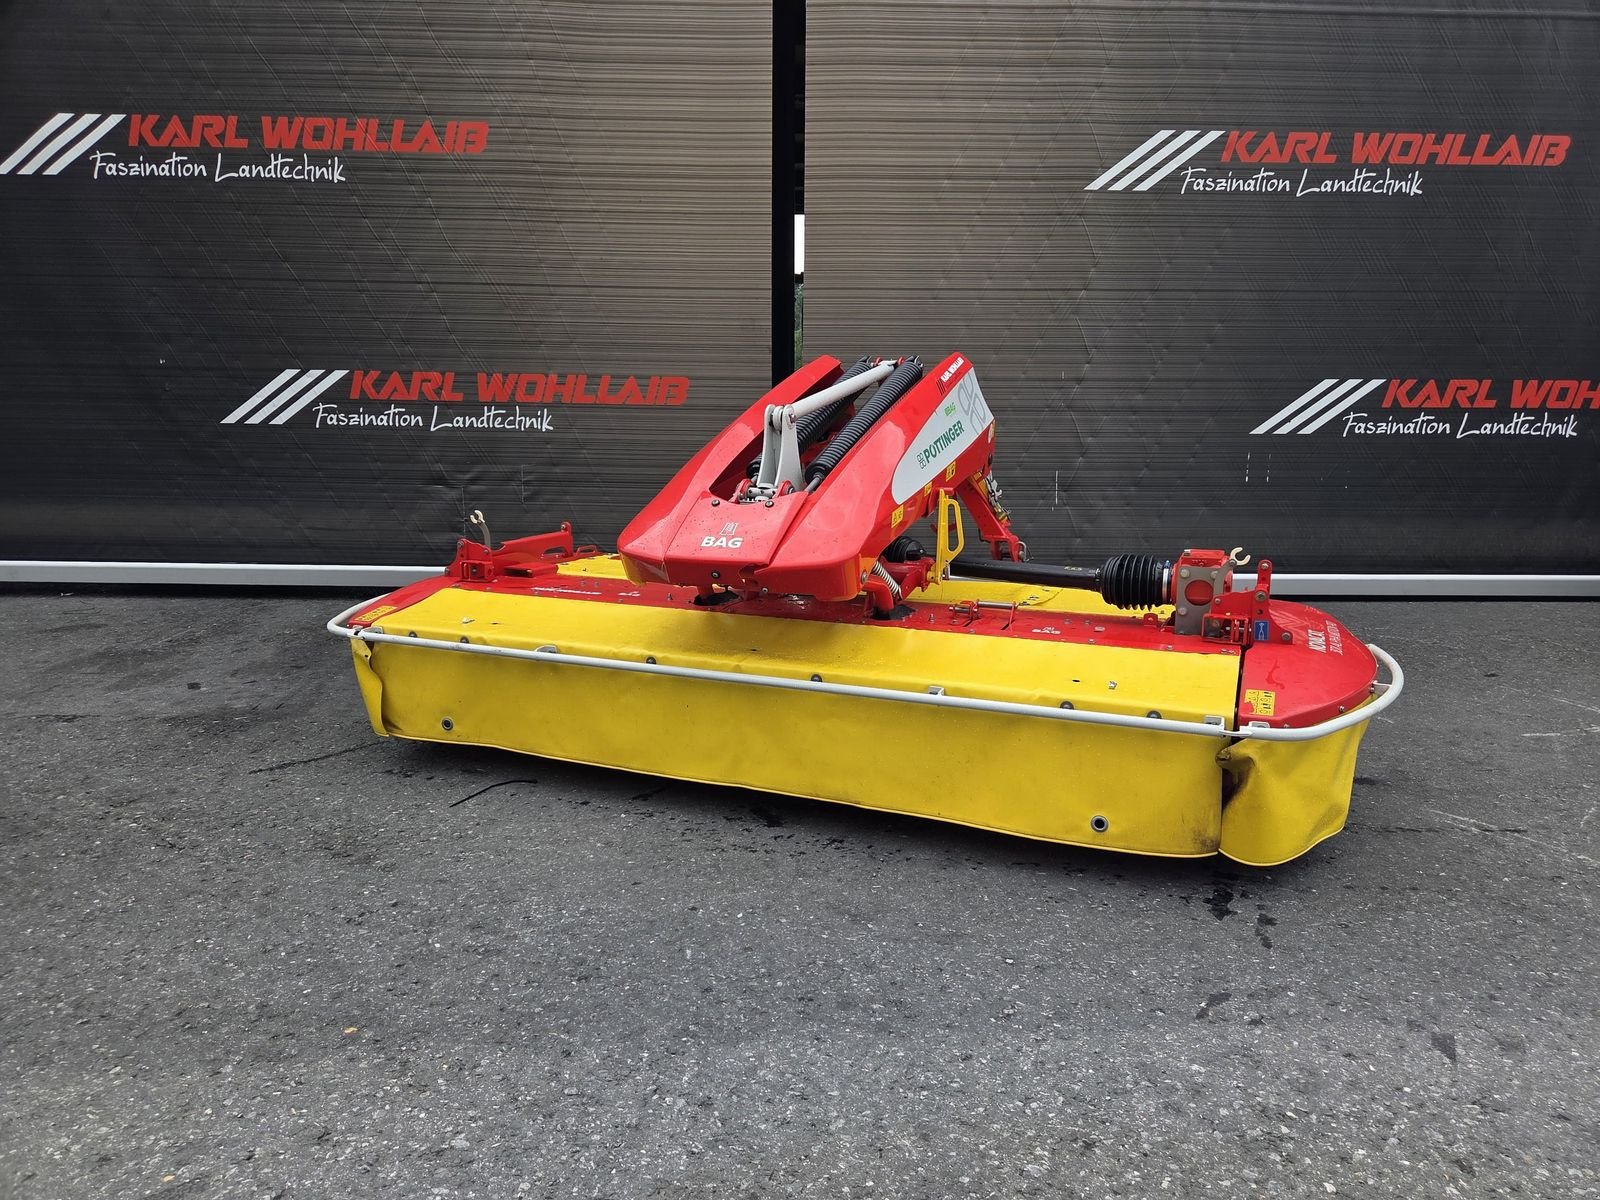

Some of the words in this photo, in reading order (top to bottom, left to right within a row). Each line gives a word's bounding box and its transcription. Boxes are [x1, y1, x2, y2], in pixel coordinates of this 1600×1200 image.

[129, 114, 249, 148] KARL
[1221, 131, 1337, 164] KARL
[90, 151, 207, 180] Faszination
[214, 153, 346, 184] Landtechnik
[1181, 167, 1290, 195] Faszination
[1296, 168, 1423, 198] Landtechnik
[350, 370, 464, 401] KARL
[1382, 379, 1497, 408] KARL
[312, 402, 424, 429] Faszination
[430, 405, 554, 432] Landtechnik
[1342, 411, 1451, 438] Faszination
[1456, 411, 1578, 439] Landtechnik
[701, 535, 743, 549] BAG
